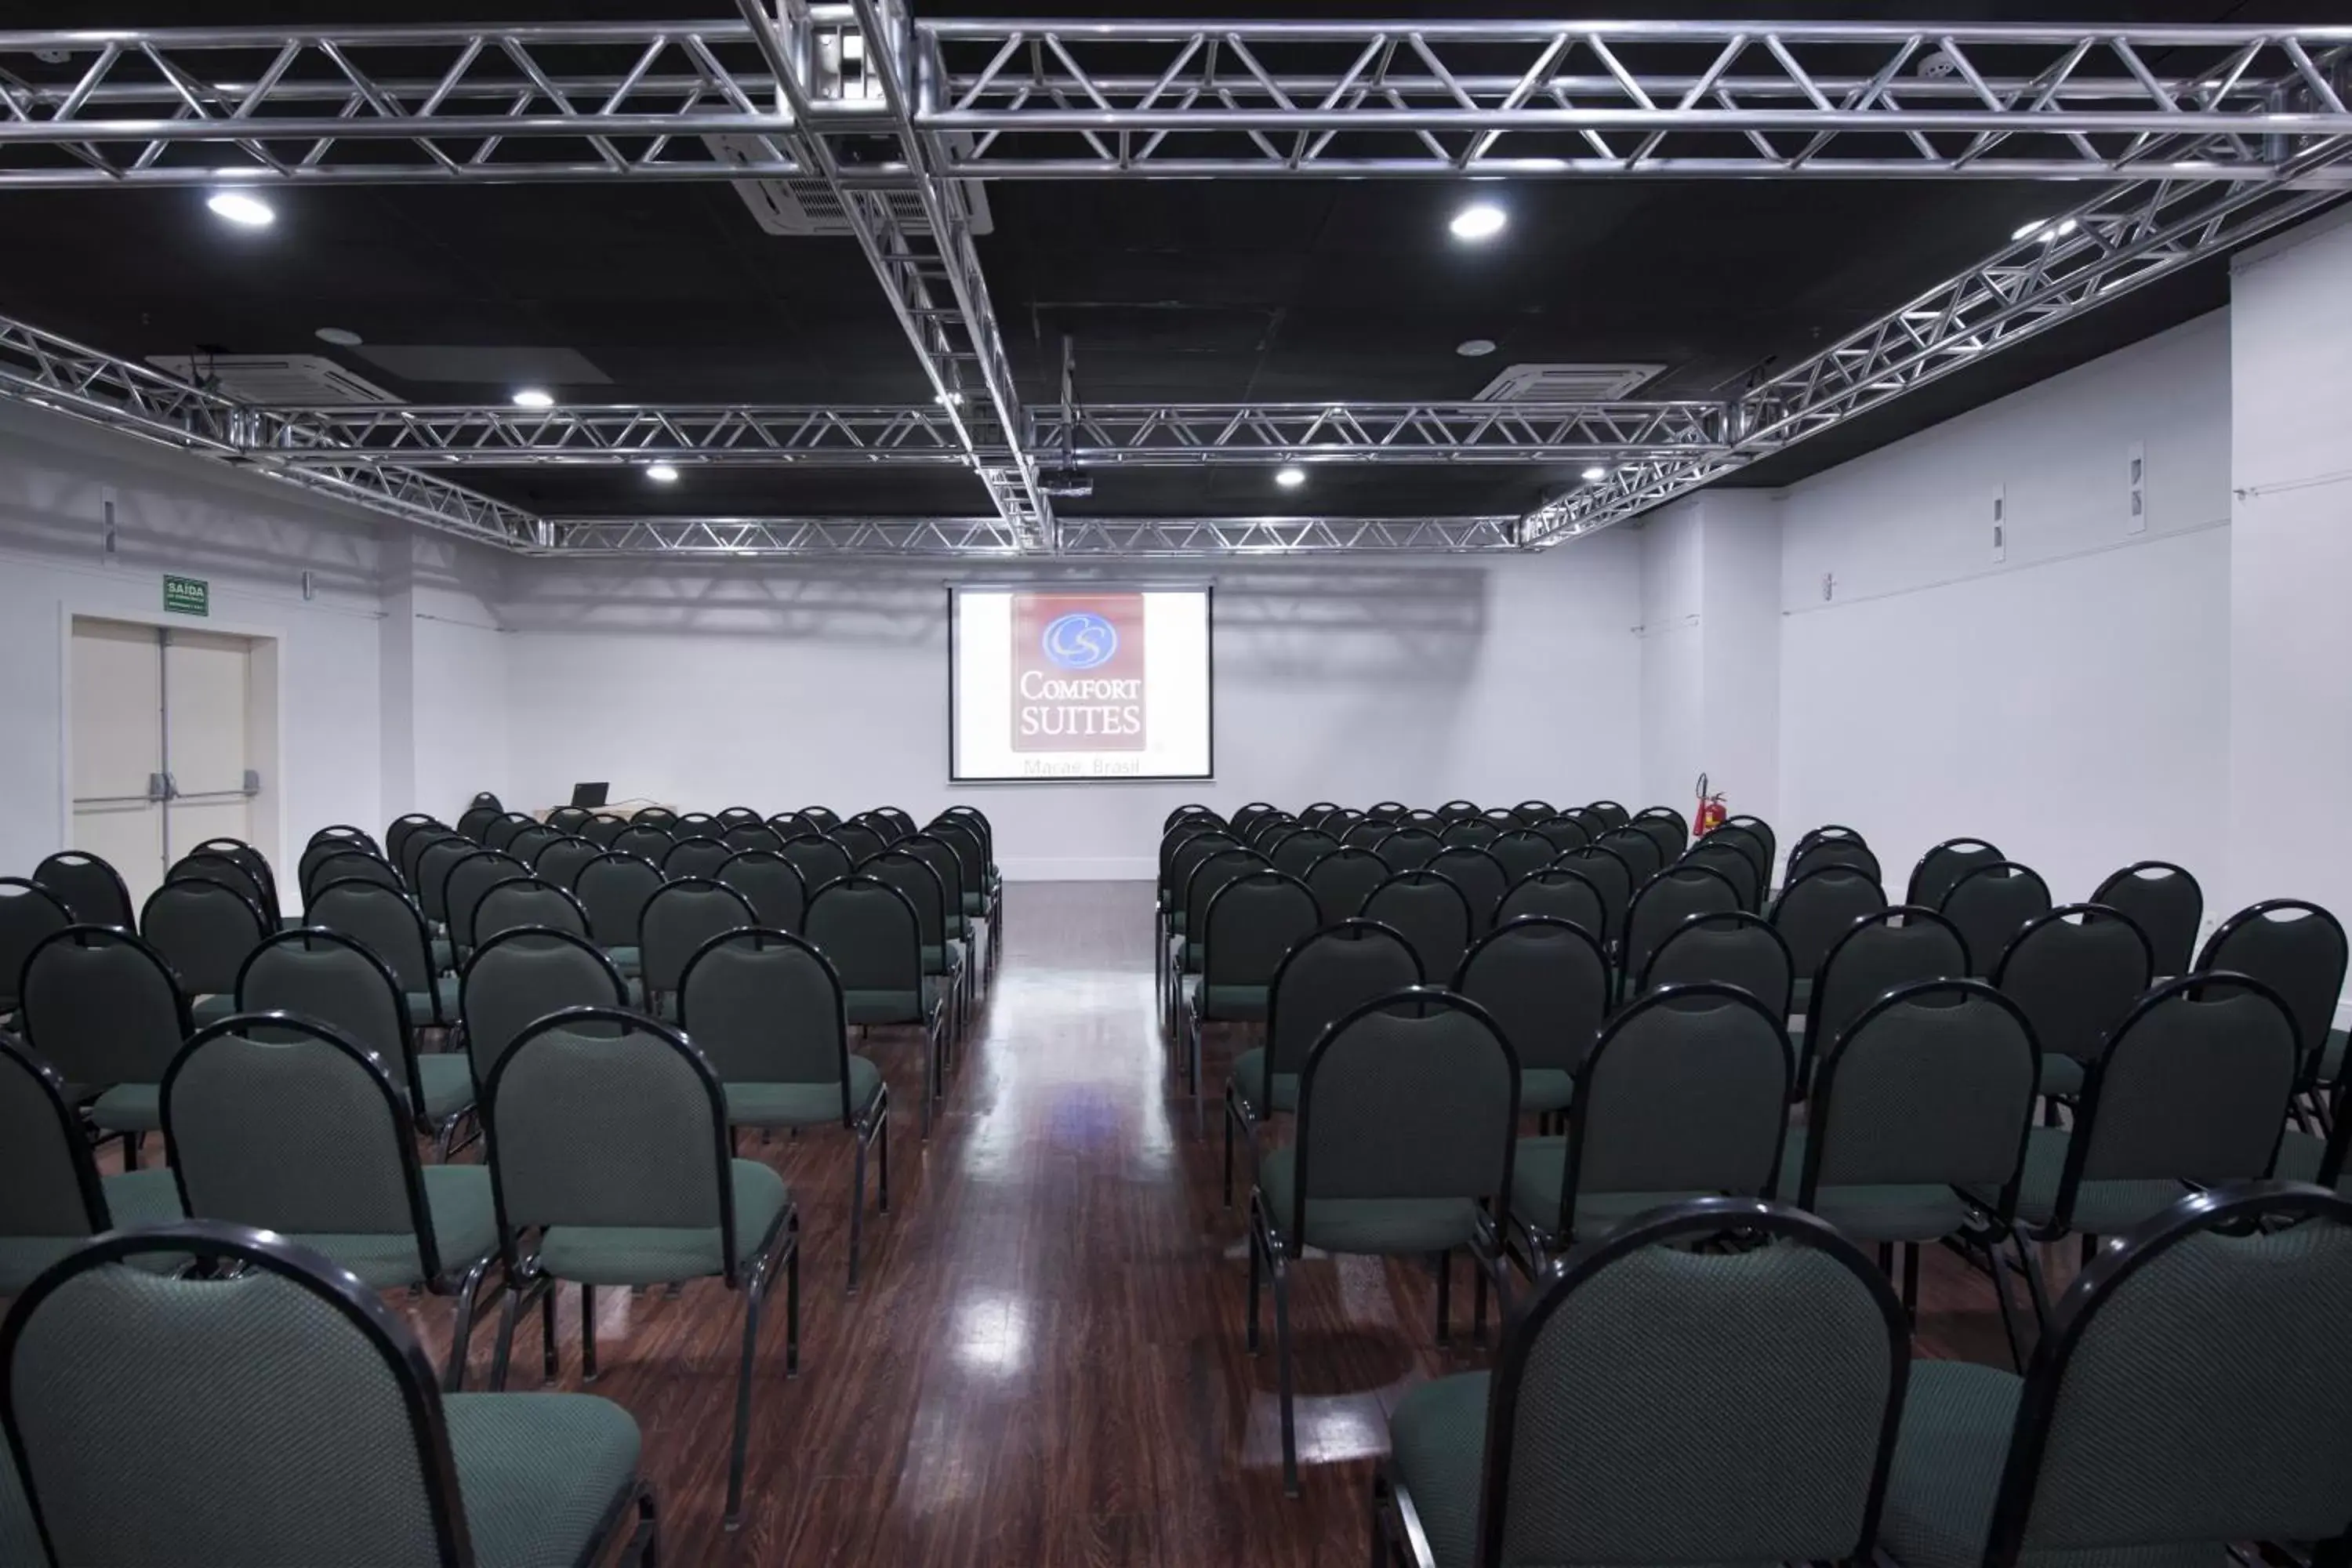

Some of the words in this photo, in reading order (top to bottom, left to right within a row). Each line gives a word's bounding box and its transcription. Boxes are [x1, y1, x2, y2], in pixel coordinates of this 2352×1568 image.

[1020, 670, 1142, 700] COMFORT
[1020, 706, 1142, 735] SUITES
[1093, 757, 1140, 775] Brasil
